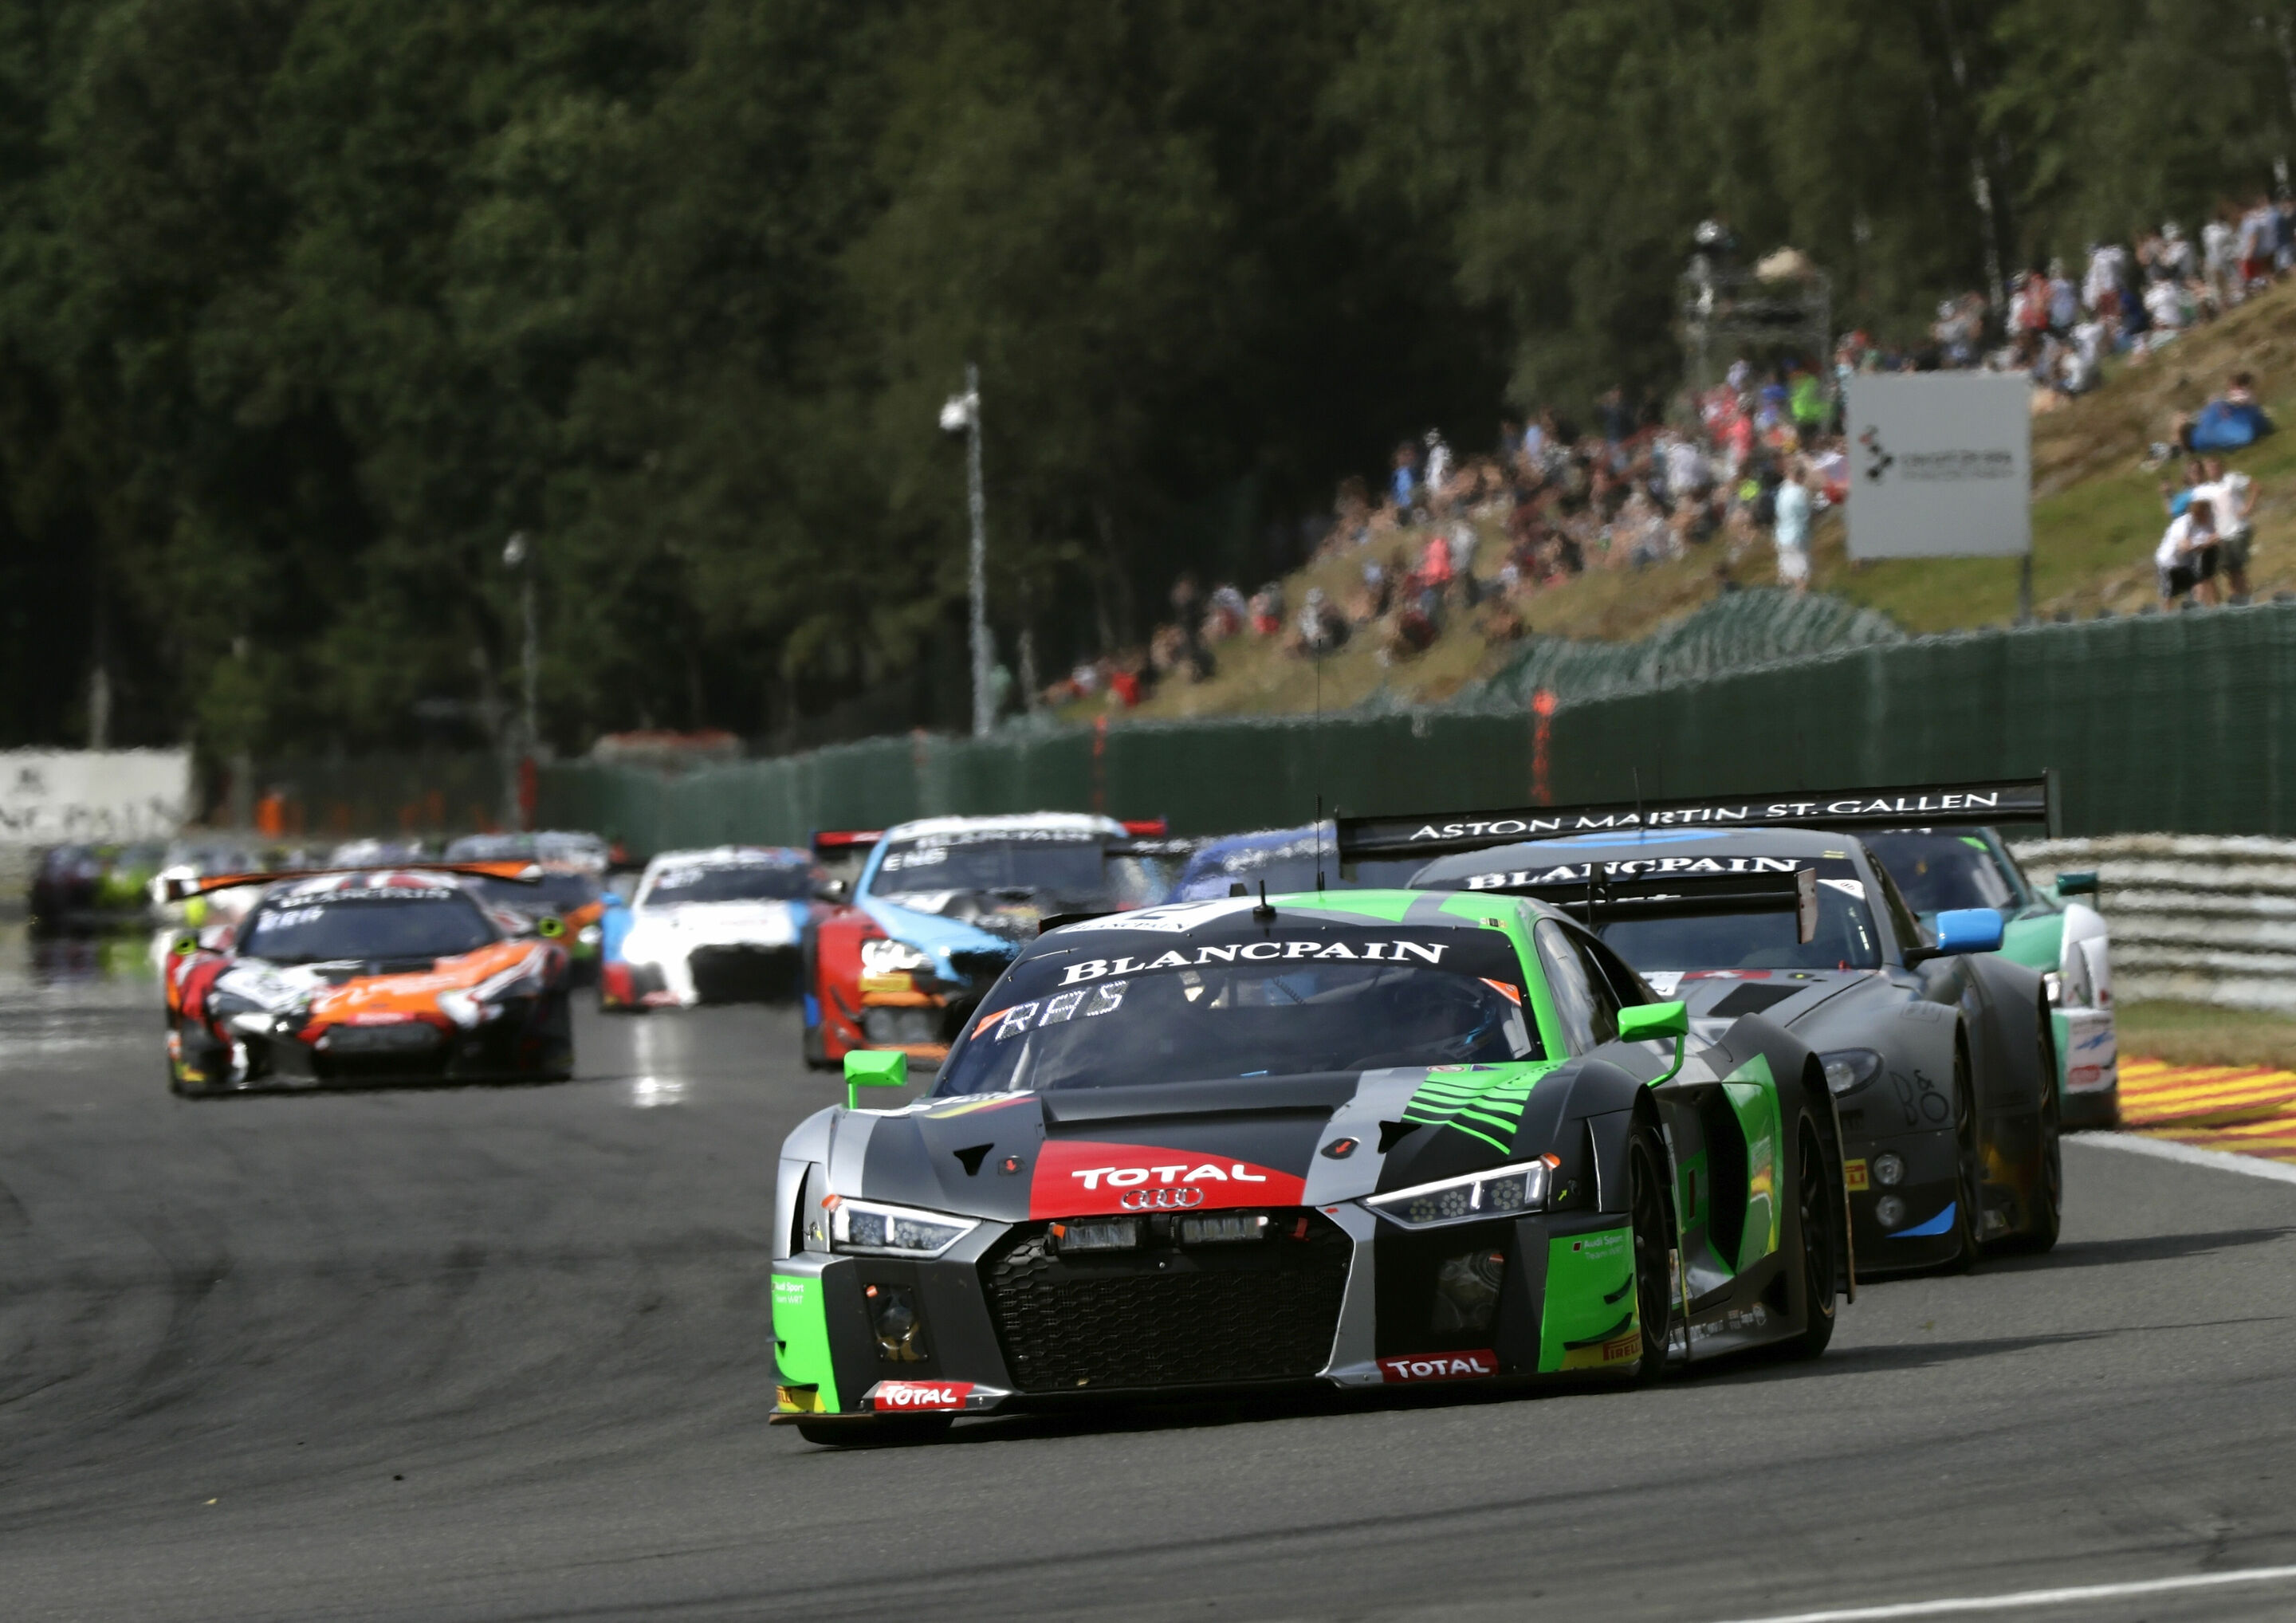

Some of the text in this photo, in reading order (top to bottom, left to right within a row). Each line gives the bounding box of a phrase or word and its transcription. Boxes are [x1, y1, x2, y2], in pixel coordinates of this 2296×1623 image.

[1409, 817, 1561, 841] ASTON
[1575, 806, 1748, 829] MARTIN
[1468, 856, 1802, 890] BLANCPAIN
[1057, 940, 1450, 987] BLANCPAIN
[994, 979, 1130, 1040] RAS
[1071, 1163, 1268, 1190] TOTAL
[1386, 1357, 1491, 1379] TOTAL
[885, 1385, 957, 1406] TOTAL
